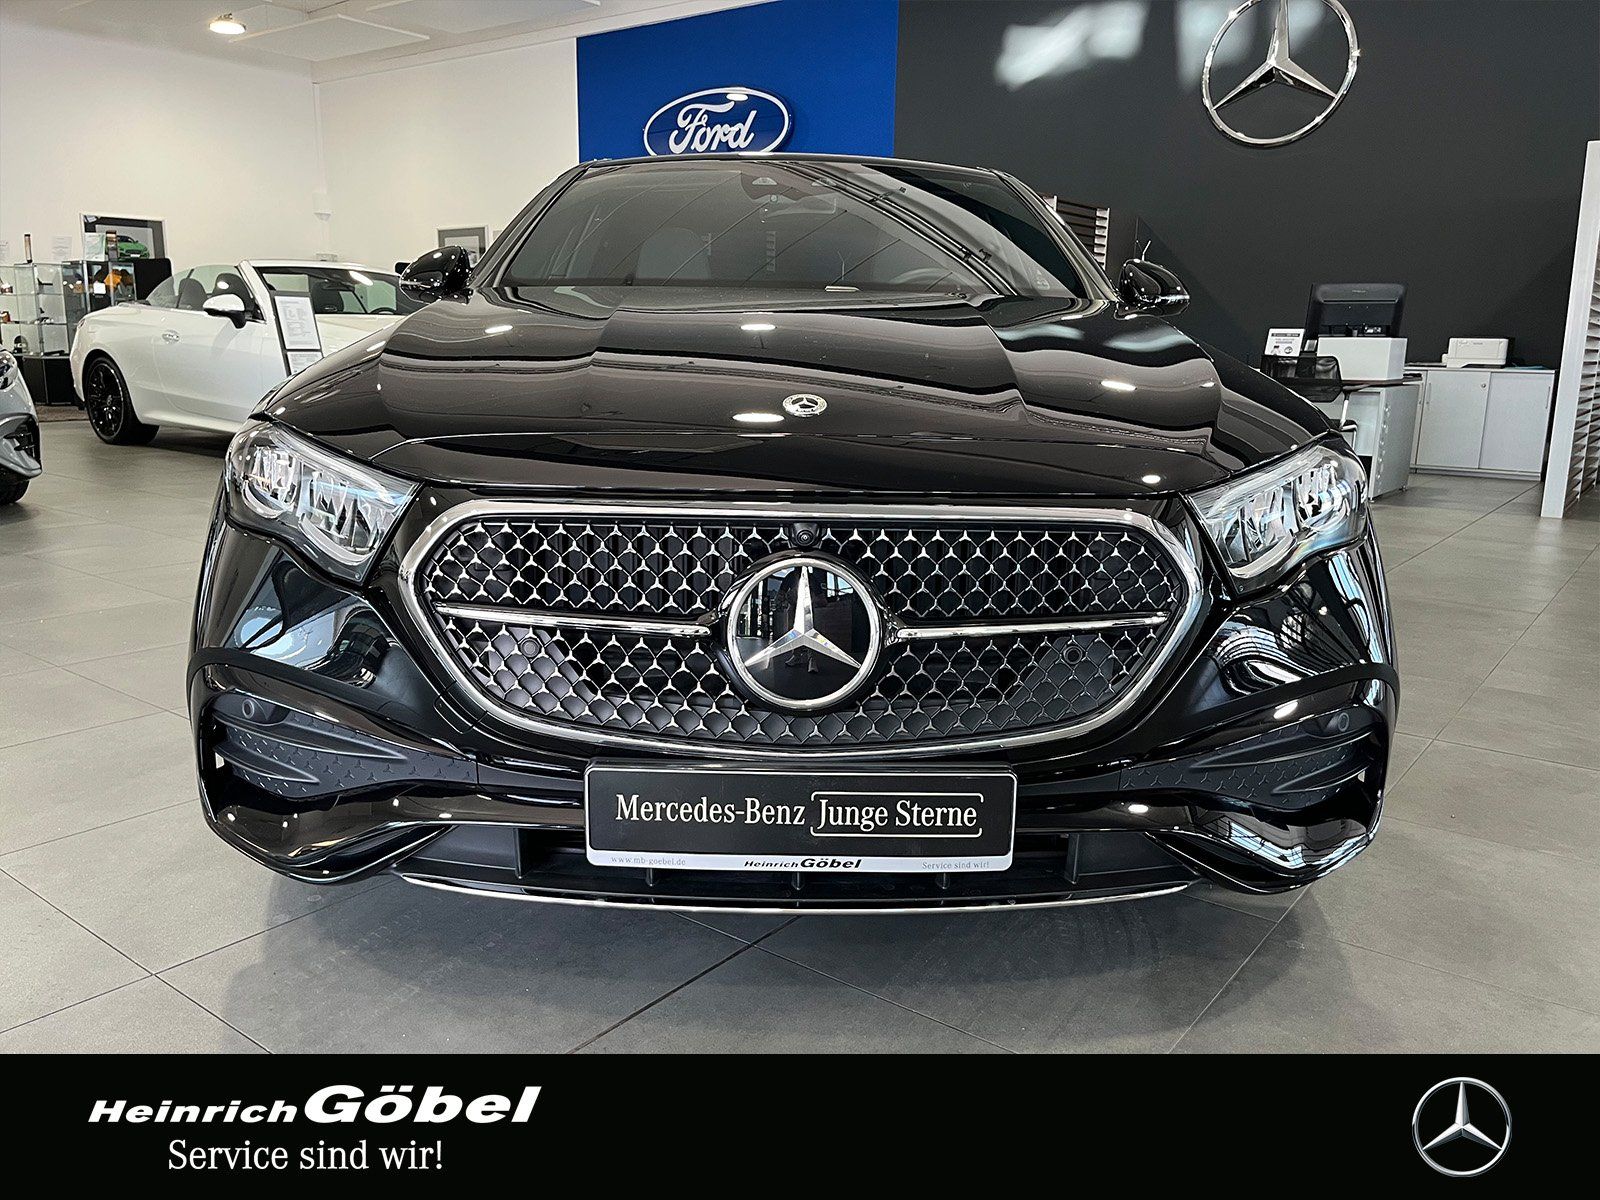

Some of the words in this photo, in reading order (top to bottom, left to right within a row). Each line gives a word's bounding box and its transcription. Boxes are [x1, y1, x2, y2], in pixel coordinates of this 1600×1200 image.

[668, 101, 758, 154] Ford
[615, 793, 806, 826] Mercedes-Benz
[816, 799, 889, 832] Junge
[895, 799, 977, 828] Sterne
[743, 860, 799, 868] Heinrich
[800, 858, 862, 869] Göbel
[922, 861, 952, 869] Service
